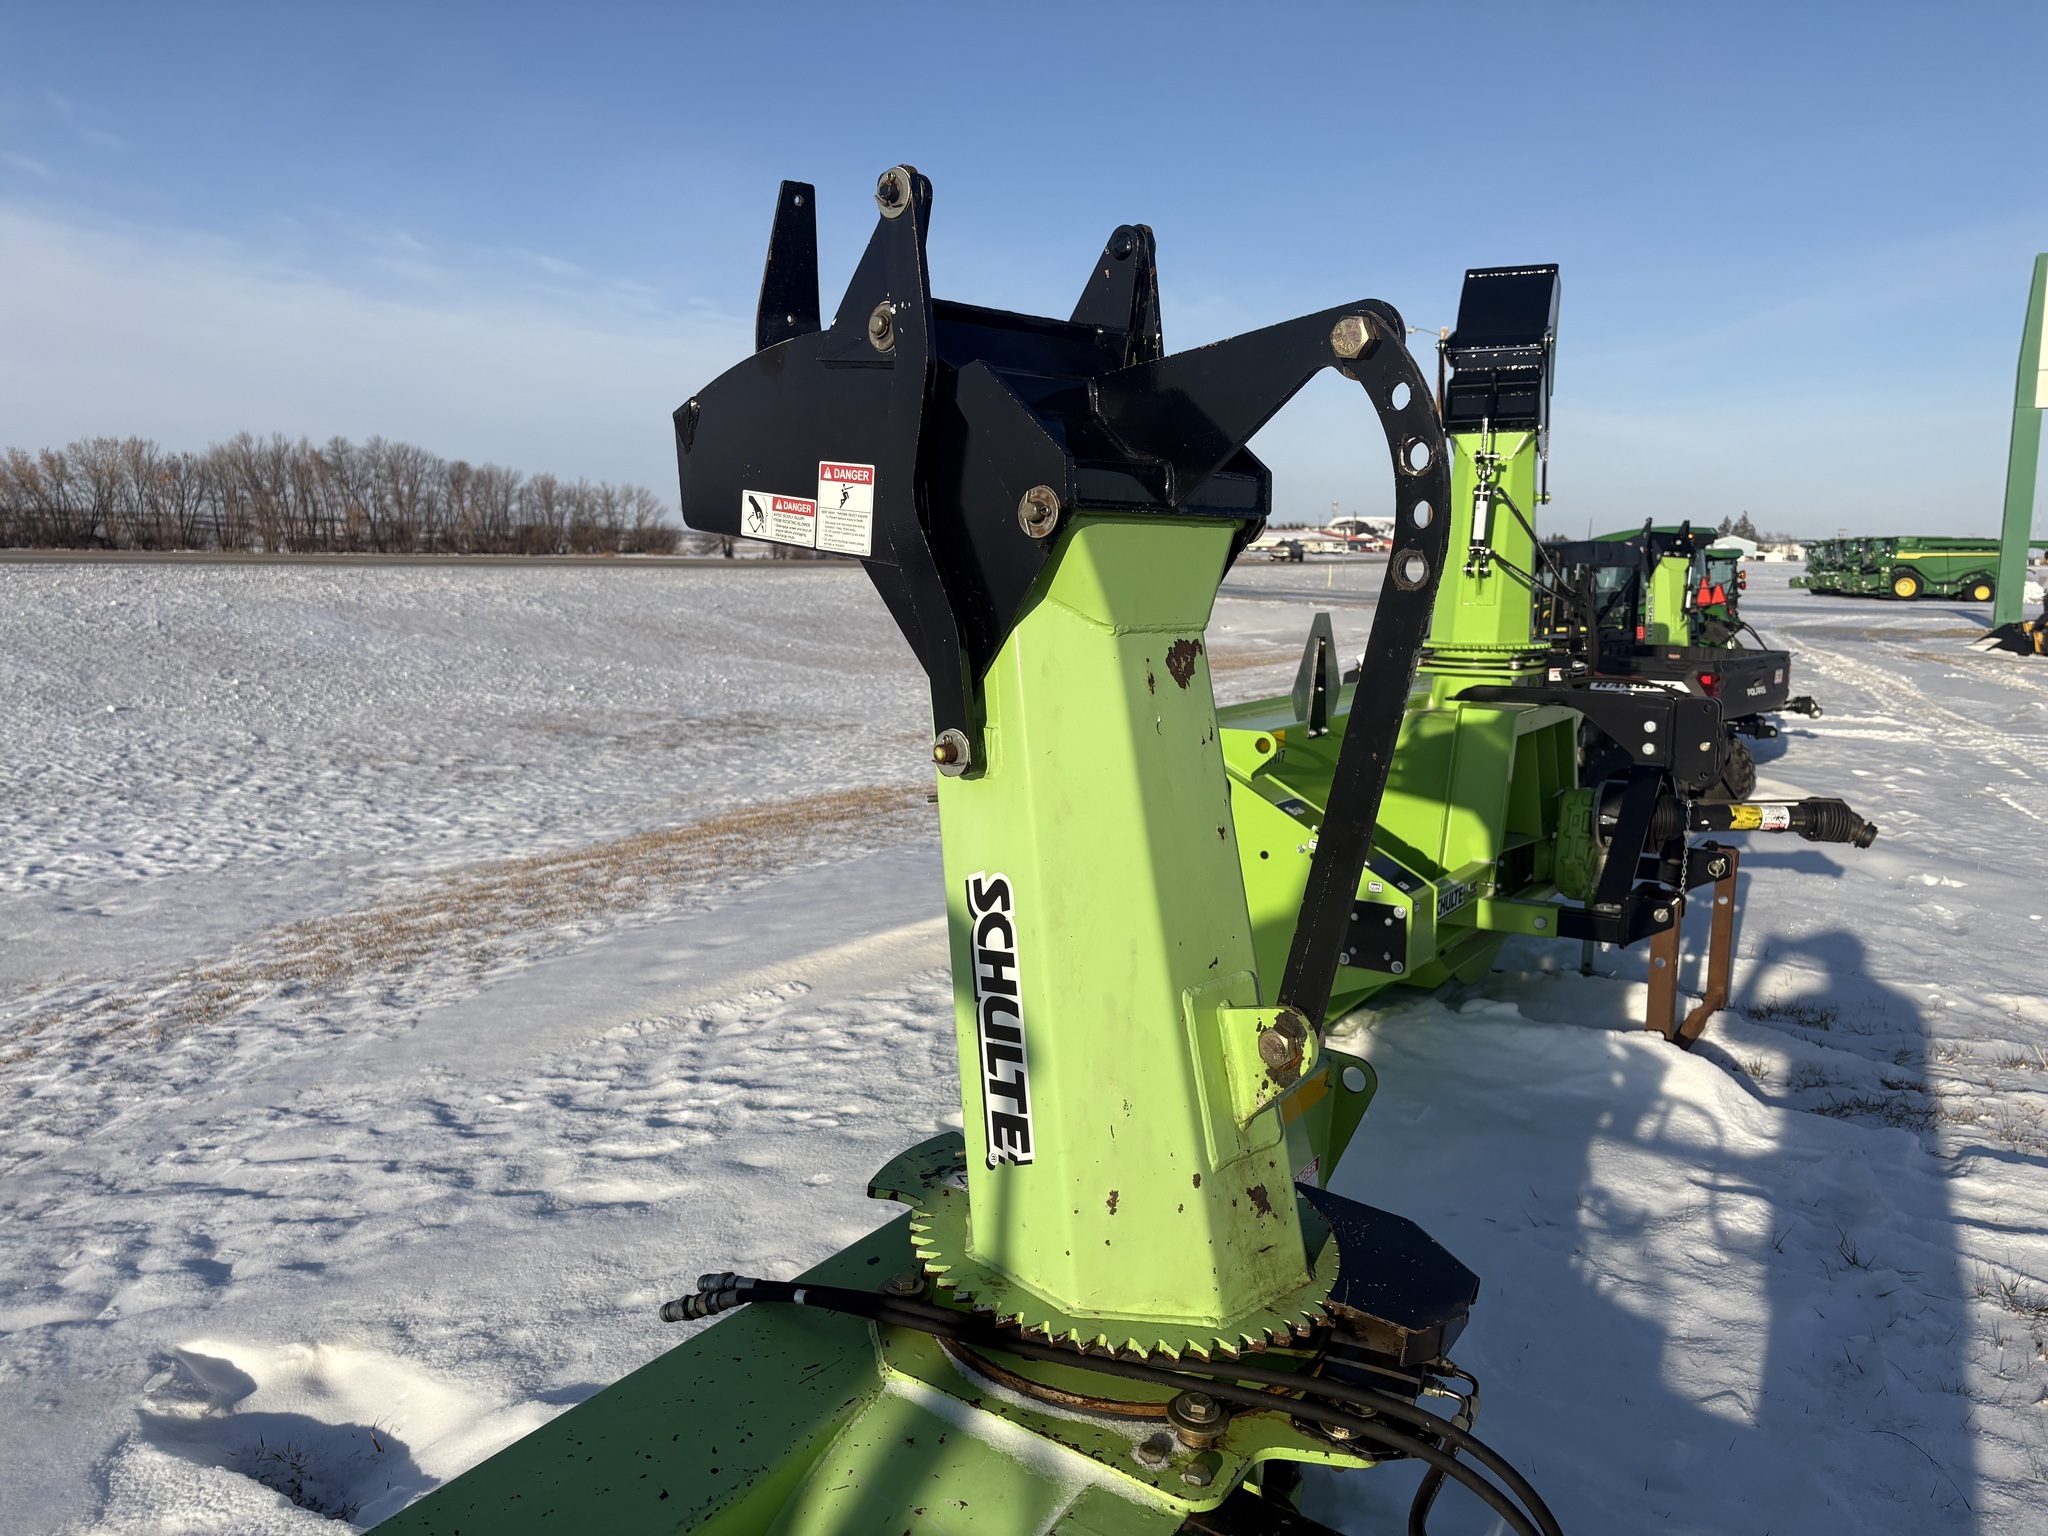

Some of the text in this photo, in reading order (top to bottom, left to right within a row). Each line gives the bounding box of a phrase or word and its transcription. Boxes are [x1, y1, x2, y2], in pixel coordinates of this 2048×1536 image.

[833, 467, 870, 482] DANGER
[783, 500, 812, 514] DANGER
[1746, 684, 1767, 697] POLARIS
[968, 872, 1034, 1160] SCHULTE
